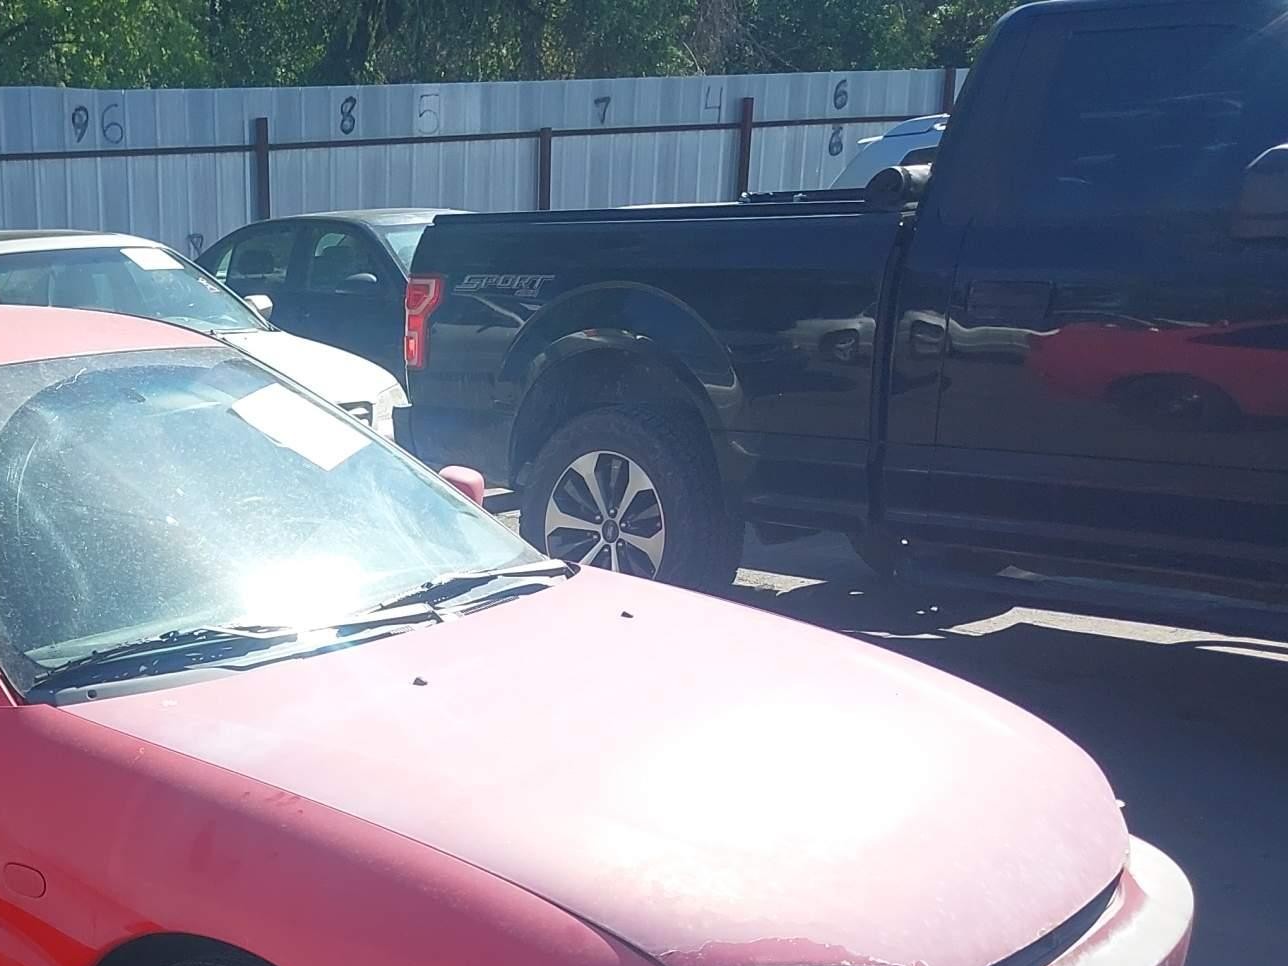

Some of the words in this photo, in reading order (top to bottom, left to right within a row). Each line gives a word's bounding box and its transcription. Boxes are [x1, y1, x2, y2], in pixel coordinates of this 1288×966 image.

[594, 96, 611, 125] 7
[704, 86, 723, 124] 4
[834, 79, 848, 110] 6
[340, 95, 357, 135] 8
[417, 93, 440, 135] 5
[454, 273, 555, 293] SPORT
